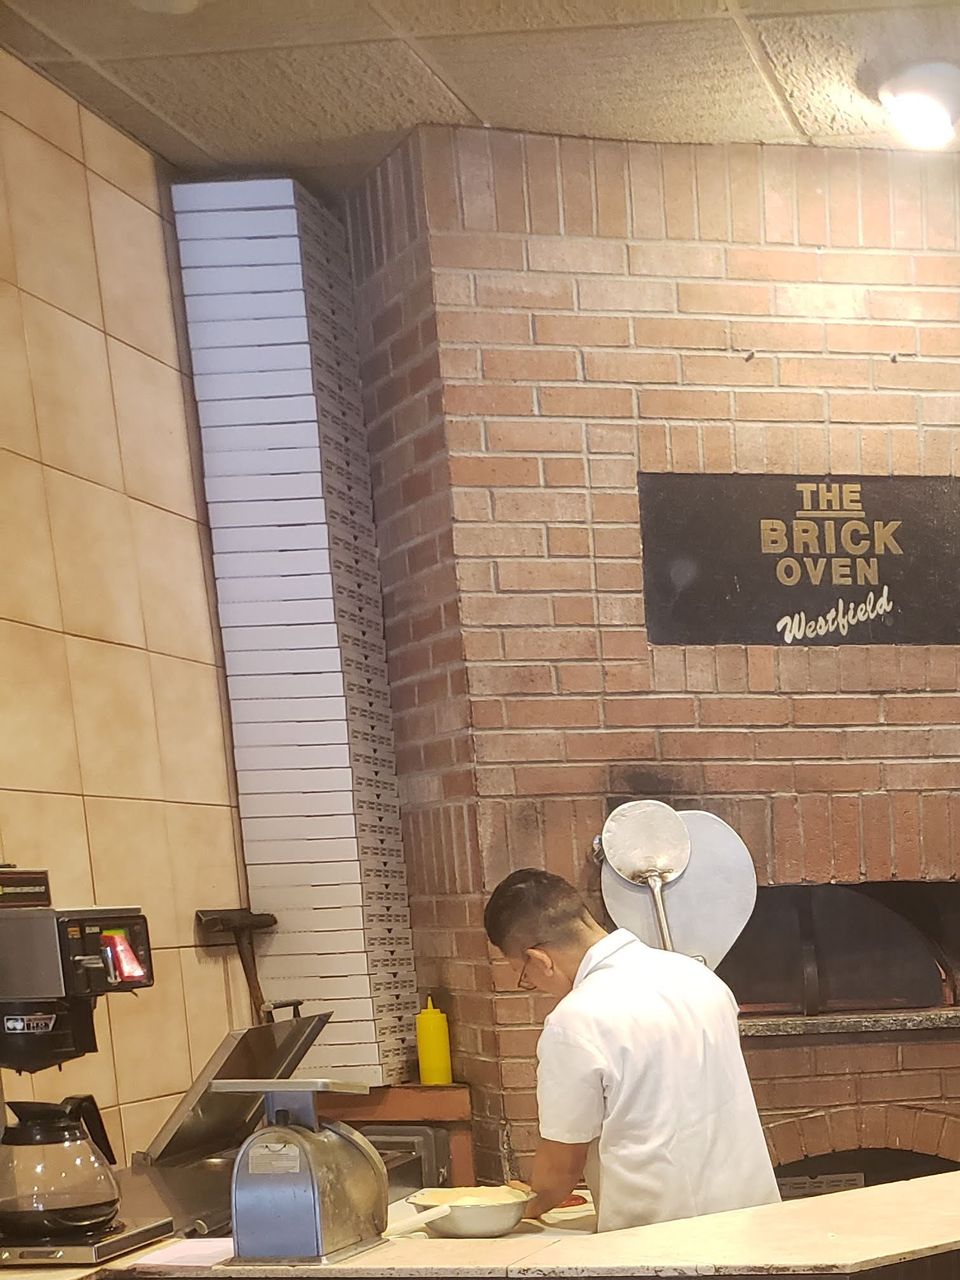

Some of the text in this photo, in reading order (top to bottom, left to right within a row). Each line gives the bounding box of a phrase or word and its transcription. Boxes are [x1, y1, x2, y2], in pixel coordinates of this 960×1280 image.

[796, 483, 863, 510] THE
[760, 519, 903, 555] BRICK
[775, 558, 879, 586] OVEN
[776, 585, 893, 644] Westfield
